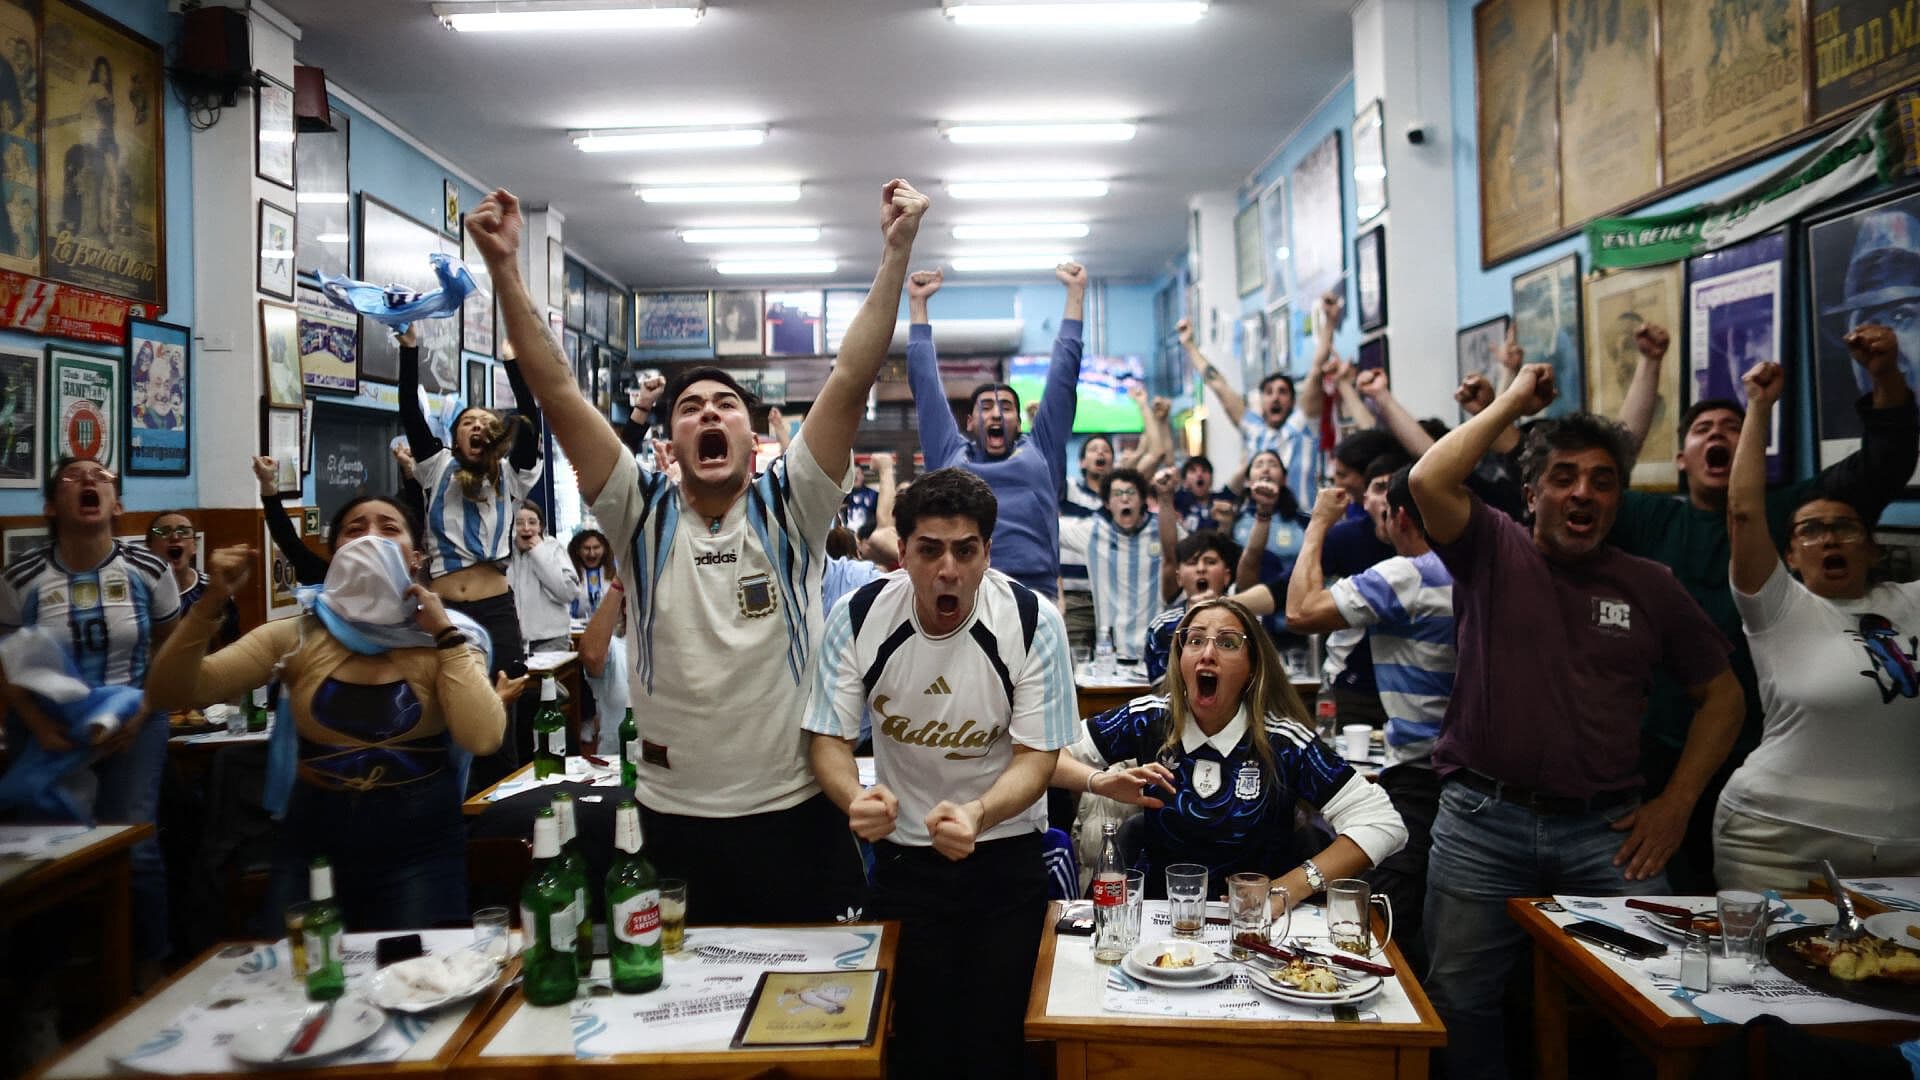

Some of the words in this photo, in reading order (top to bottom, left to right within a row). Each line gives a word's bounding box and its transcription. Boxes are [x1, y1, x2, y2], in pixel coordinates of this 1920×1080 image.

[694, 549, 737, 566] adidas
[1600, 601, 1630, 629] DC
[632, 911, 658, 924] STELLA
